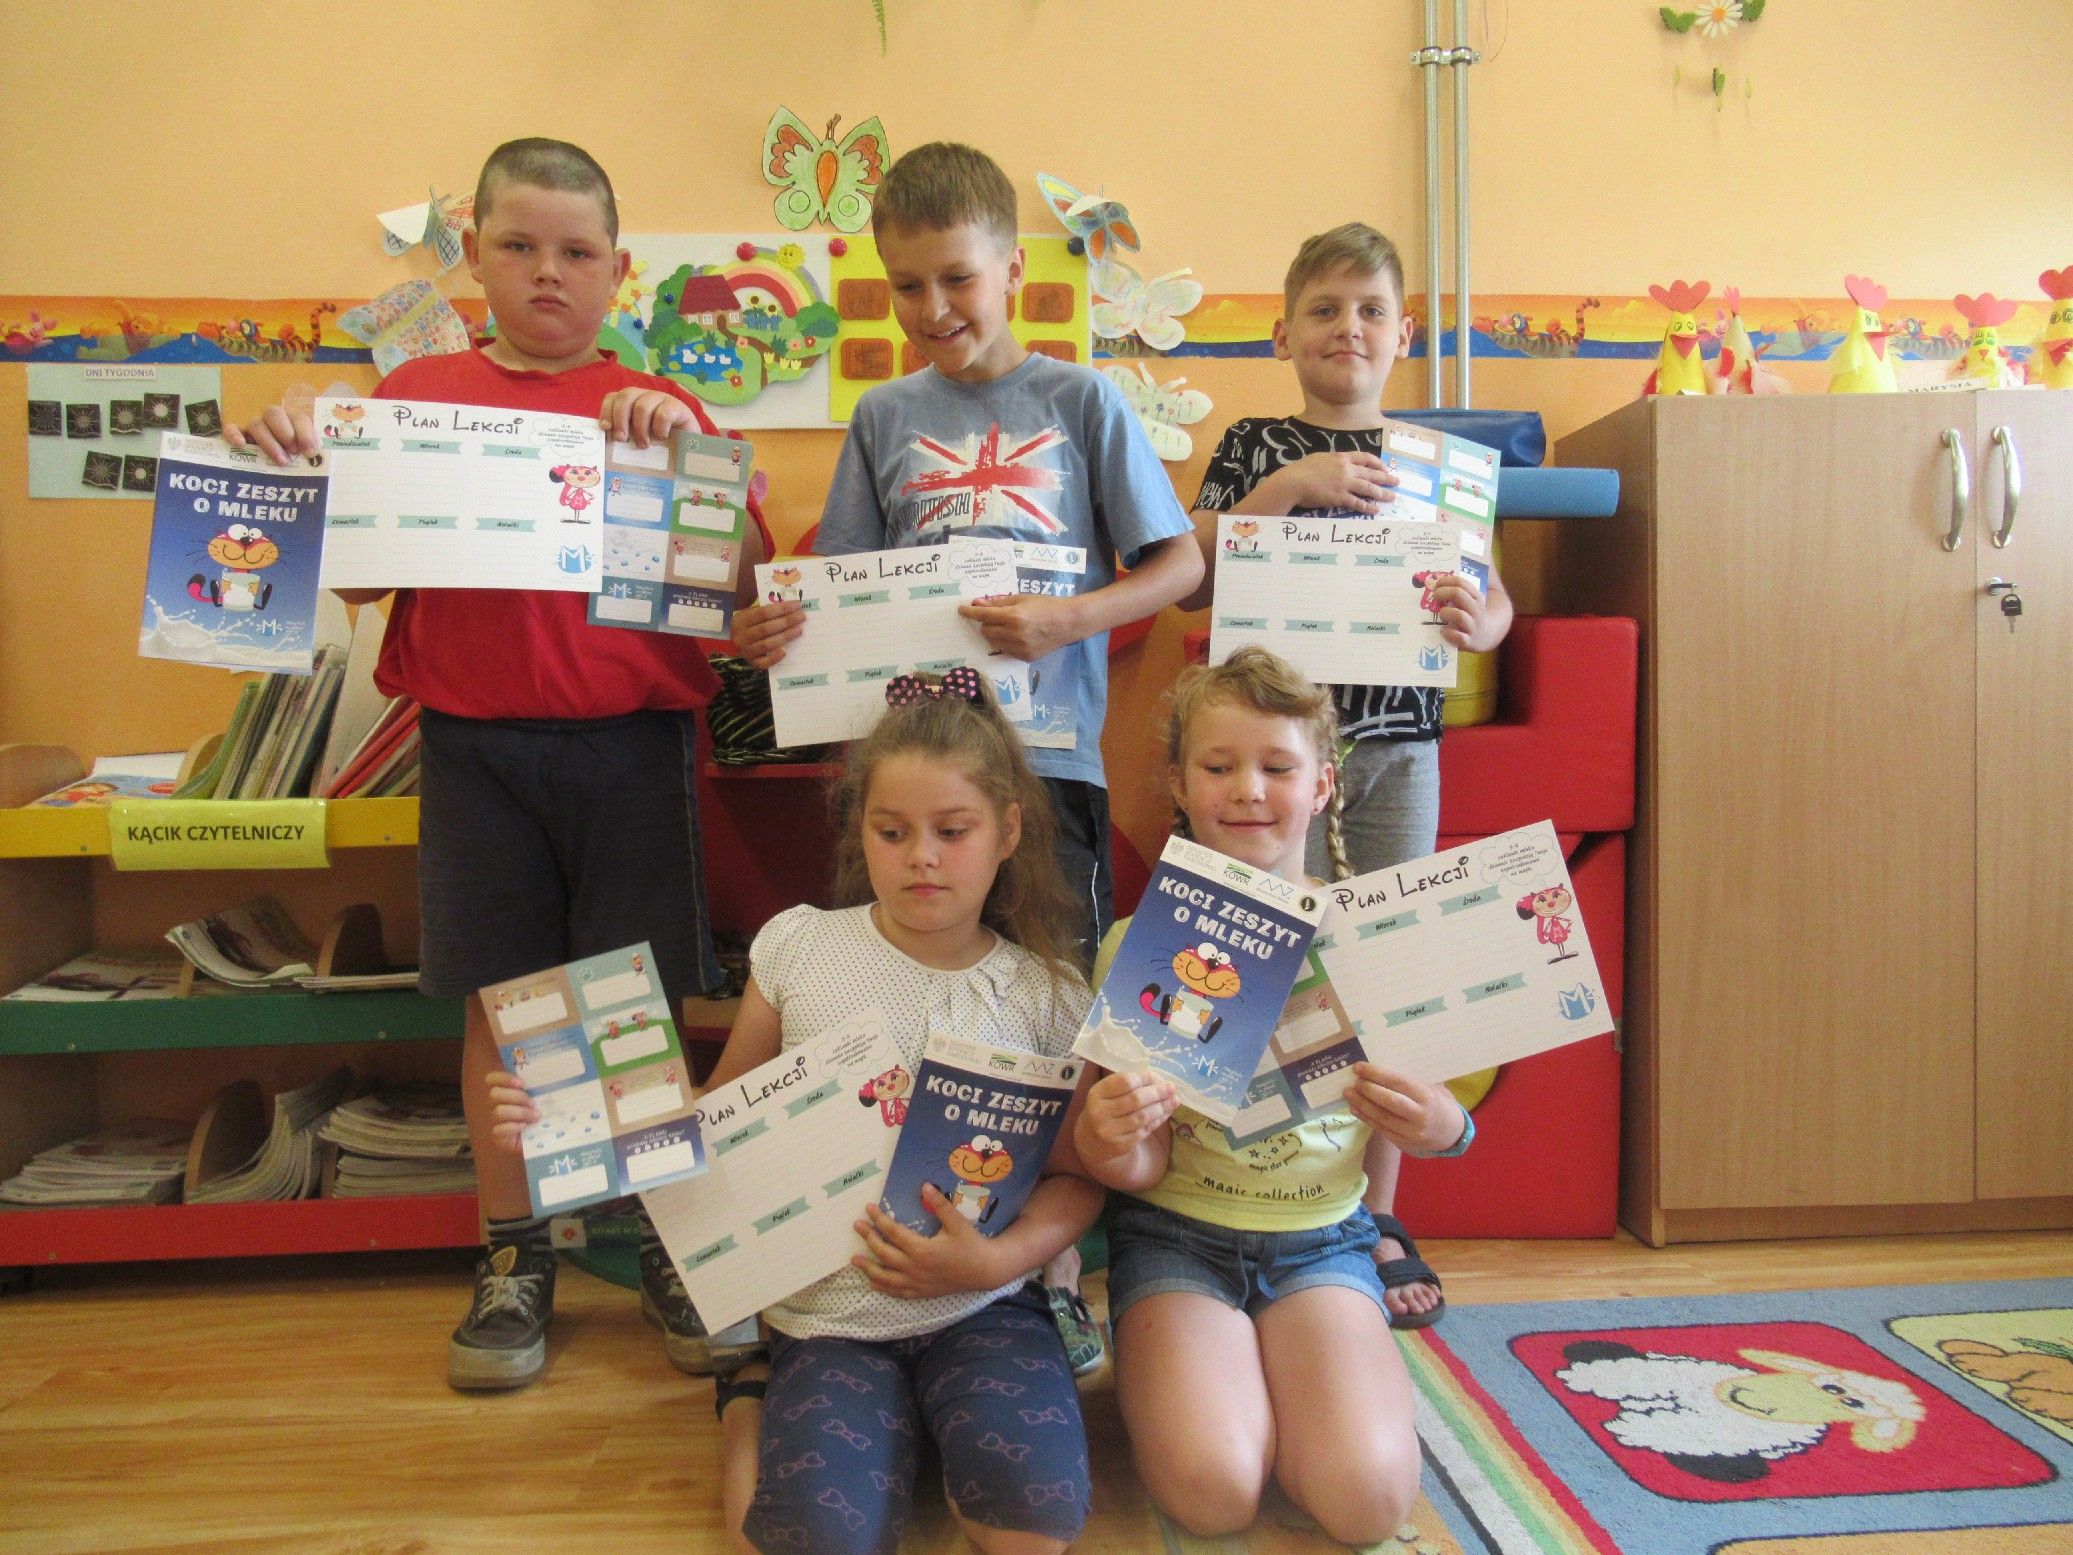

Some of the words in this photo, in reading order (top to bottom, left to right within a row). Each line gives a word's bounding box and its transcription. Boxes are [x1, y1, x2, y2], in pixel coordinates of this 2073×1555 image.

[85, 369, 102, 377] DNI
[104, 369, 154, 378] TYGODNIA
[169, 473, 228, 496] KOCI
[236, 483, 318, 504] ZESZYT
[194, 497, 210, 513] O
[218, 501, 298, 523] MLEKU
[1018, 578, 1075, 597] ESZYT
[128, 825, 182, 845] KĄCIK
[187, 825, 305, 841] CZYTELNICZY
[1223, 869, 1250, 886] KOWR
[1159, 876, 1215, 910] KOCI
[1218, 900, 1301, 948] ZESZYT
[1174, 906, 1191, 923] O
[1194, 914, 1273, 960] MLEKU
[989, 1061, 1016, 1072] KOWR
[926, 1075, 983, 1103] KOCI
[988, 1089, 1061, 1117] ZESZYT
[944, 1104, 960, 1121] O
[966, 1108, 1039, 1136] MLEKU
[1255, 1184, 1325, 1201] collection
